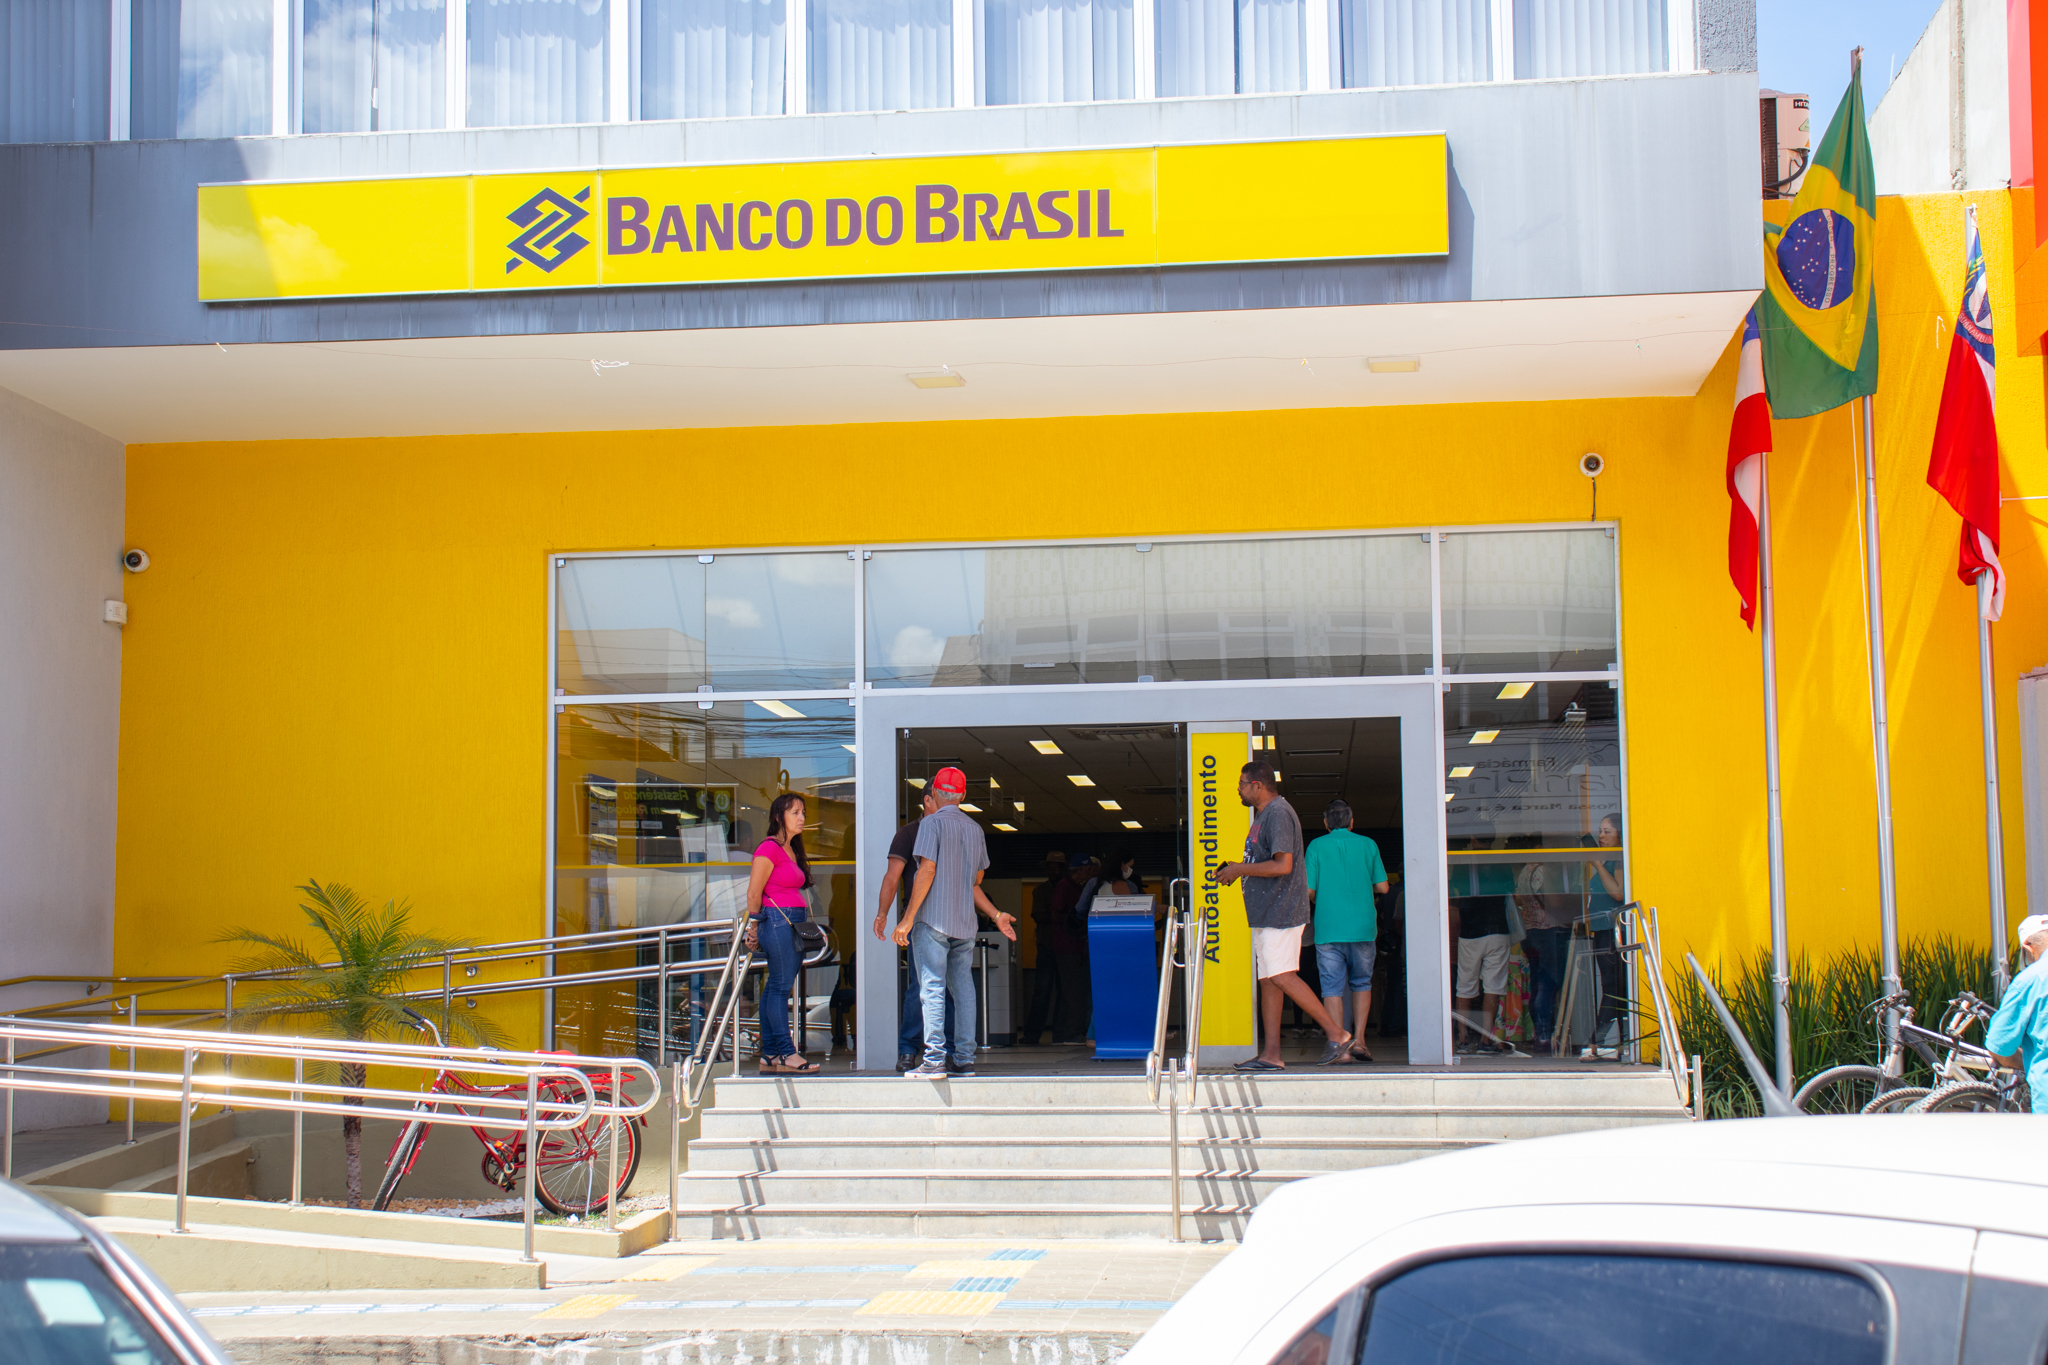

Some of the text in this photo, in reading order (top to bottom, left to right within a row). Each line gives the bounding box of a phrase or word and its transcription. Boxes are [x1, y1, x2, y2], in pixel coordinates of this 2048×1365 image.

[607, 184, 1124, 255] BANCO DO BRASIL
[1825, 254, 1836, 303] PROGRESSO
[1199, 755, 1220, 964] Autoatendimento
